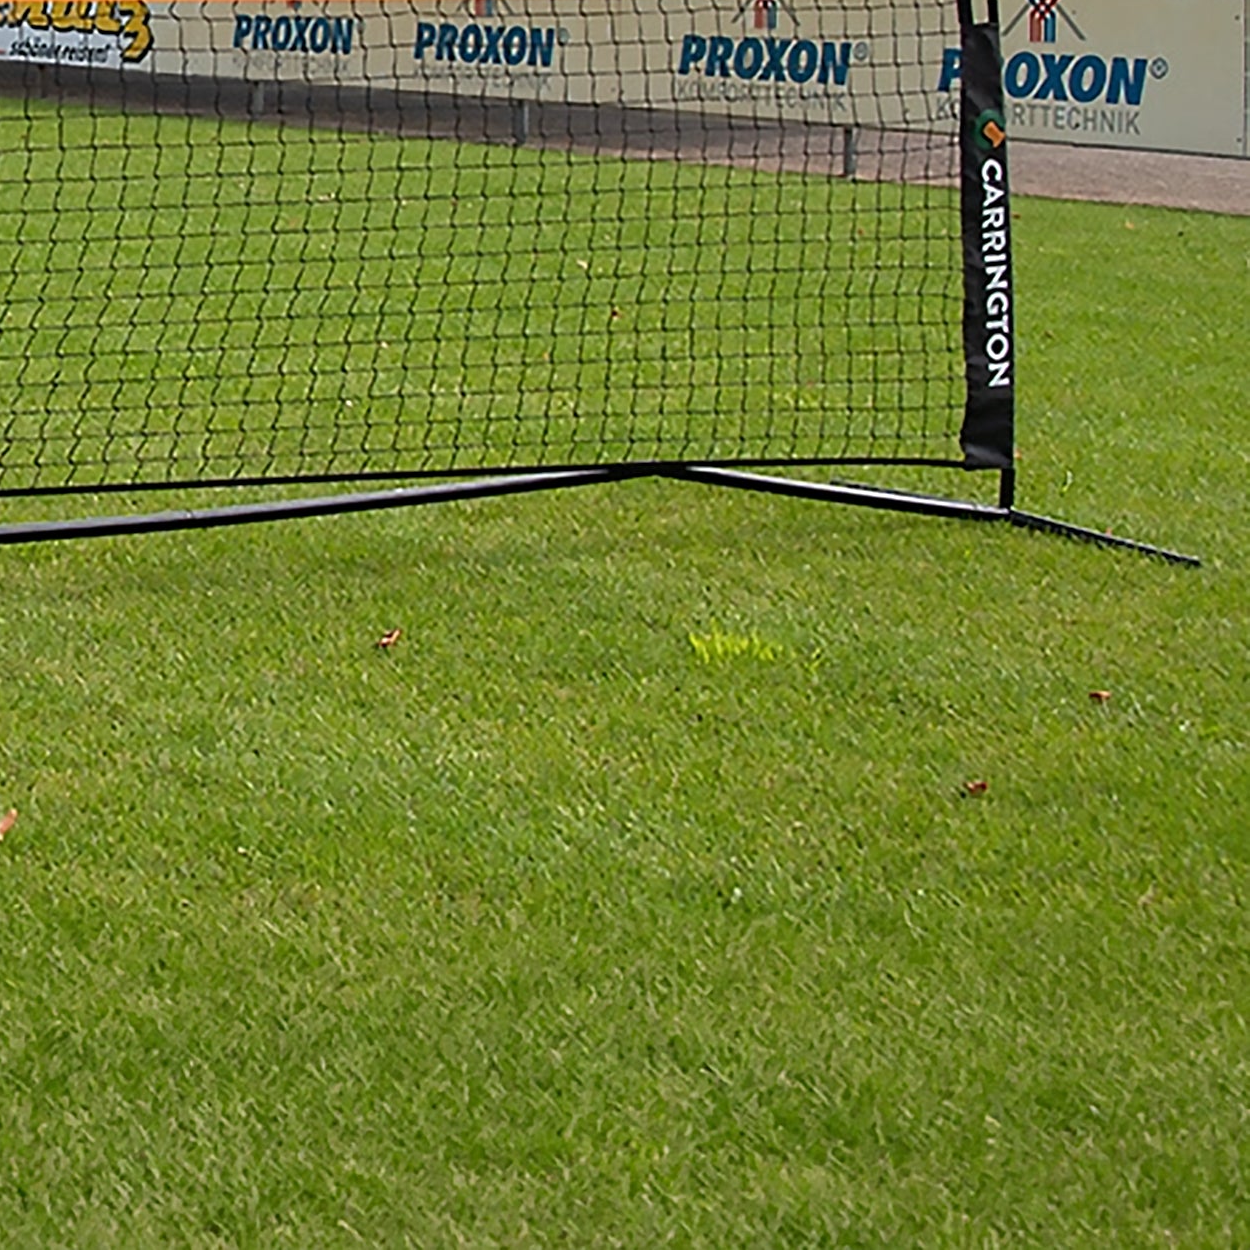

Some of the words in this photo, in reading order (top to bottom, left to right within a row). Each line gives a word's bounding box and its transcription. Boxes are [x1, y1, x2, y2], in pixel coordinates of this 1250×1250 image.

[232, 14, 354, 55] PROXON
[414, 21, 555, 68] PROXON
[678, 34, 852, 86] PROXON
[937, 48, 1148, 106] POXON
[981, 157, 1010, 388] CARRINGTON
